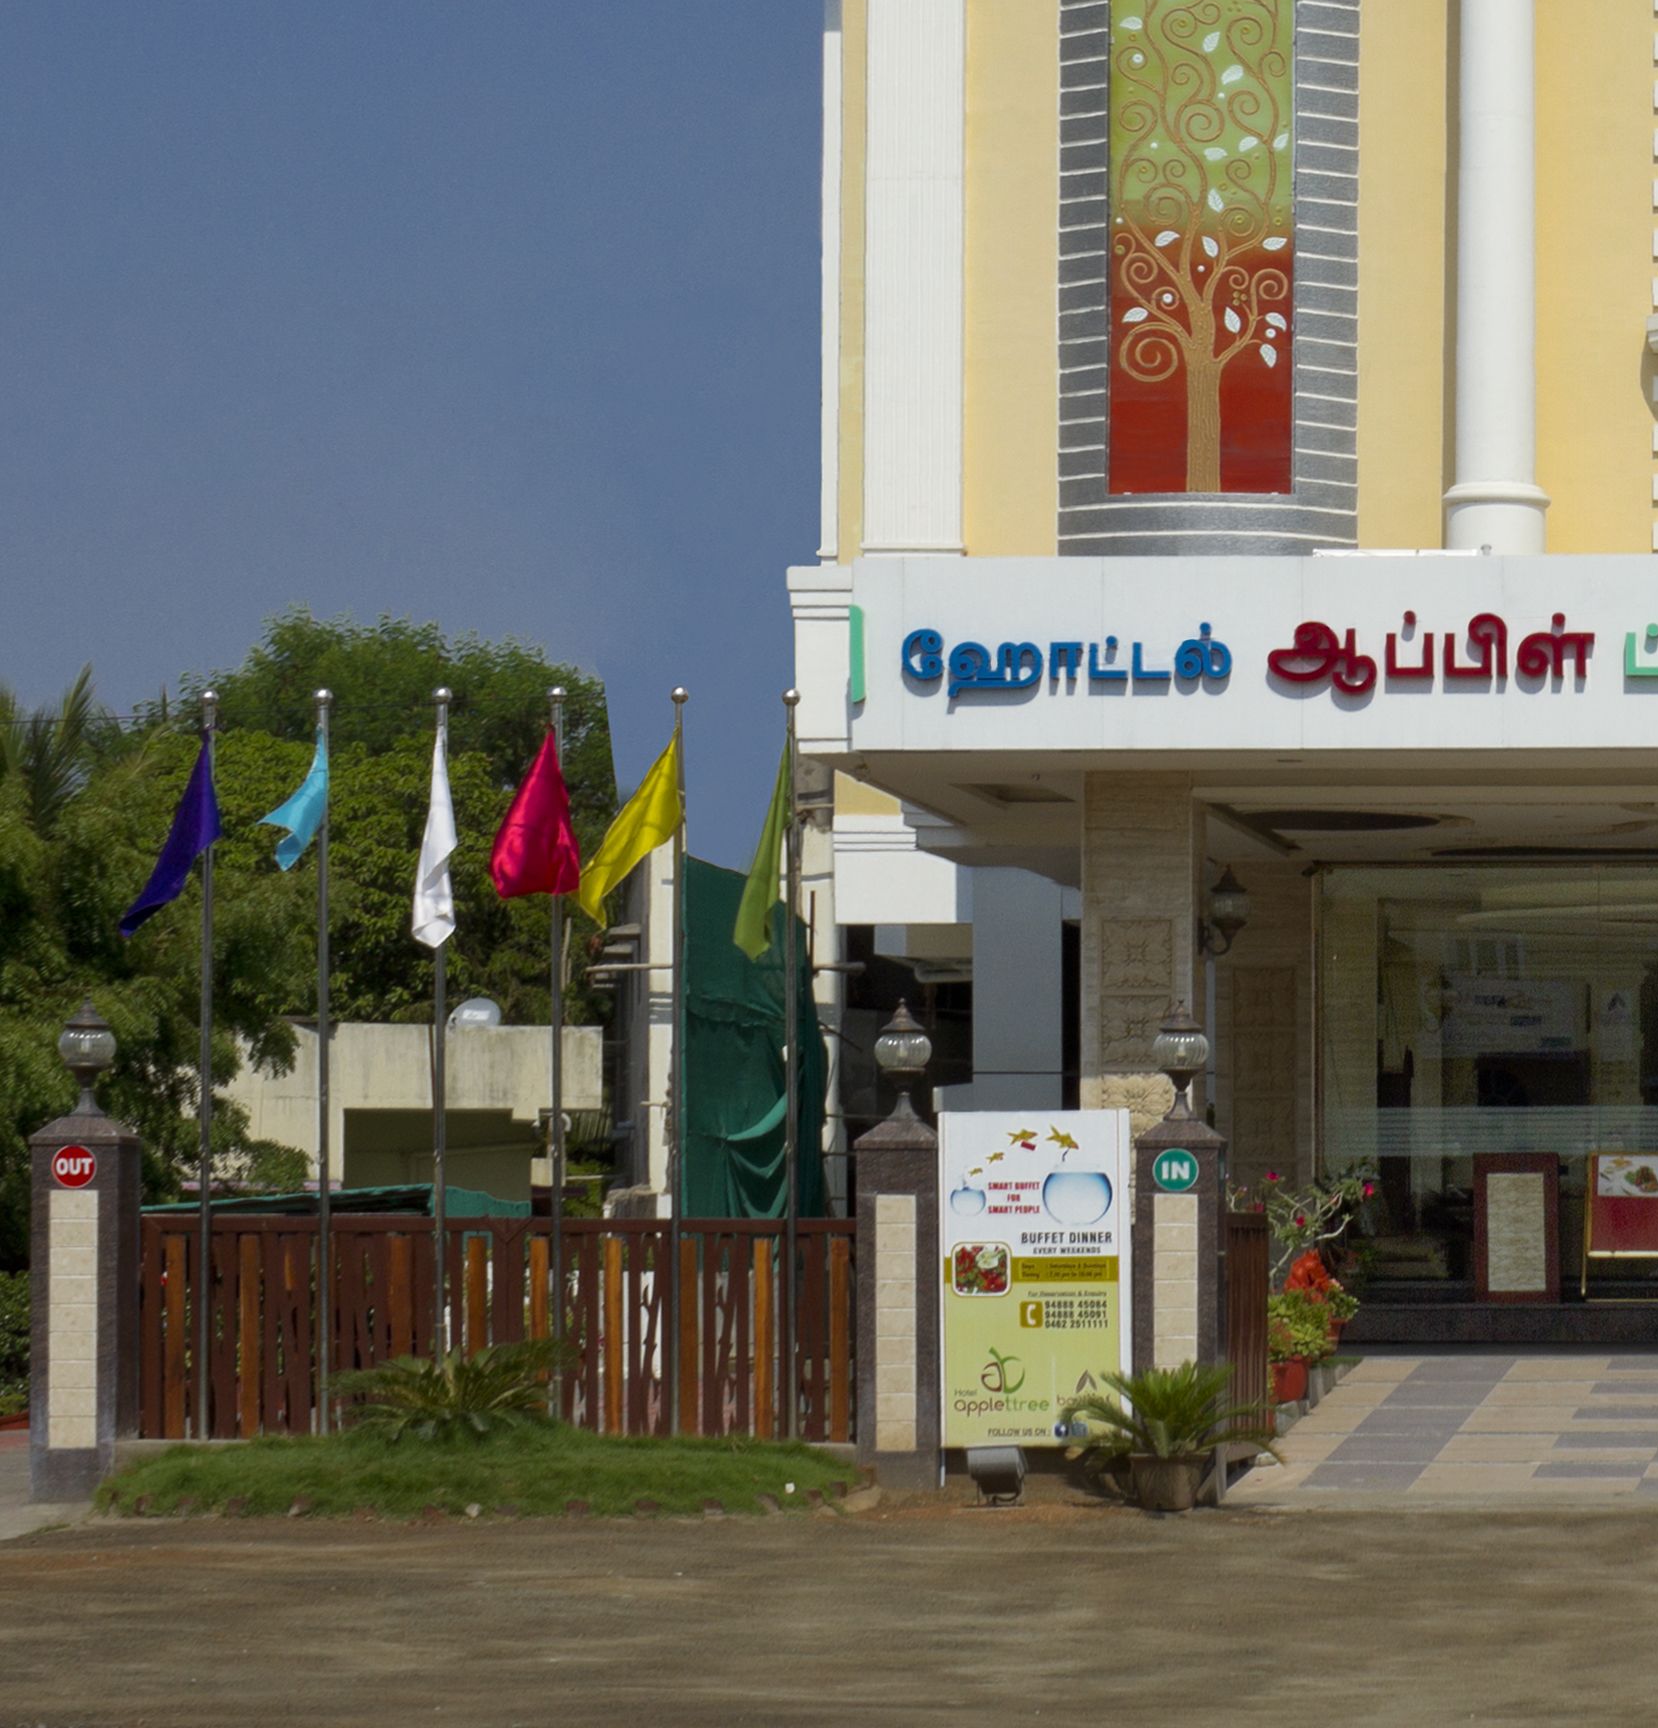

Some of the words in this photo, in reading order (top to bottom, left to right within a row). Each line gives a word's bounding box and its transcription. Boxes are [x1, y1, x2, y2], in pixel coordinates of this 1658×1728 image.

[901, 622, 1233, 698] ஹோட்டல்
[1267, 609, 1595, 696] ஆப்பிள்
[55, 1157, 94, 1176] OUT
[1161, 1161, 1190, 1180] IN
[988, 1181, 1013, 1190] SMART
[1015, 1181, 1040, 1190] BUFFET
[1007, 1193, 1021, 1202] FOR
[988, 1205, 1013, 1214] SMART
[1015, 1205, 1040, 1214] PEOPLE
[1021, 1232, 1065, 1244] BUFFET
[1069, 1232, 1113, 1244] DINNER
[1033, 1247, 1057, 1255] EVERY
[1060, 1246, 1102, 1254] WEEKENDS
[954, 1388, 977, 1397] Hotel
[953, 1396, 1050, 1418] applettree
[987, 1428, 1020, 1437] FOLLOW
[1022, 1428, 1033, 1437] US
[1034, 1427, 1047, 1437] ON
